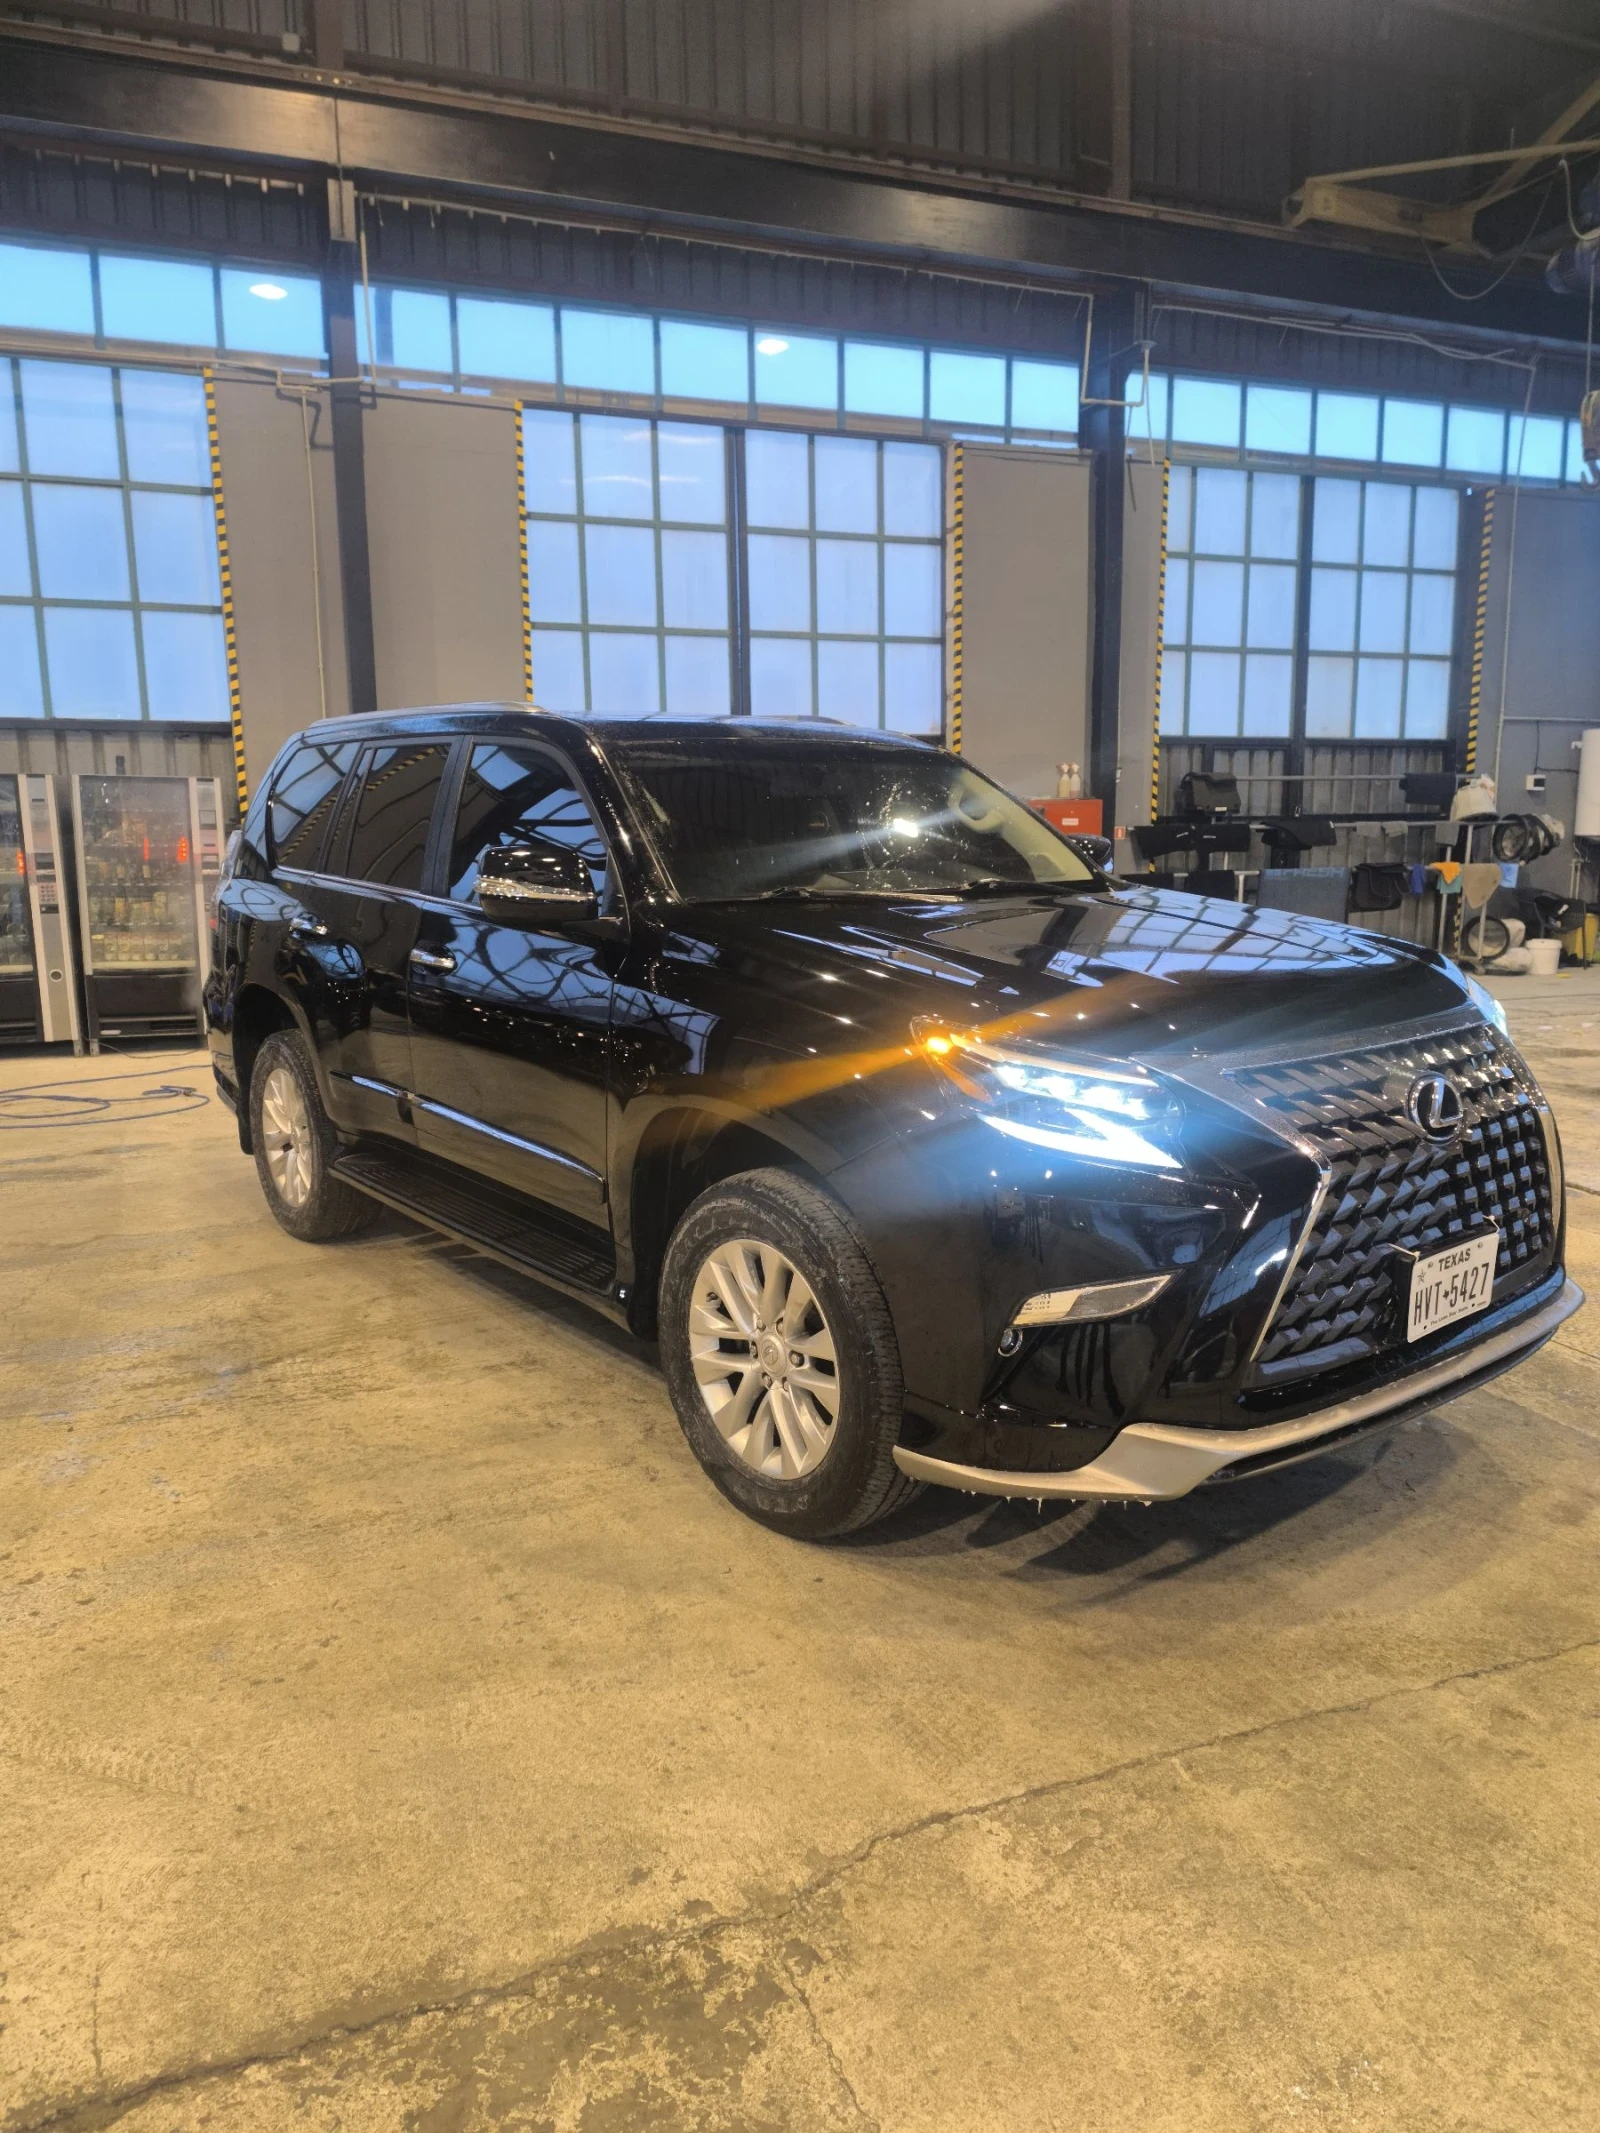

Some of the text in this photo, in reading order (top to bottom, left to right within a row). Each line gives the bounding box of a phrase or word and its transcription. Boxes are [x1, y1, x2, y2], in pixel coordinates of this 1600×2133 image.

[1438, 1248, 1471, 1272] TEXAS
[1413, 1262, 1490, 1326] HVT 5427
